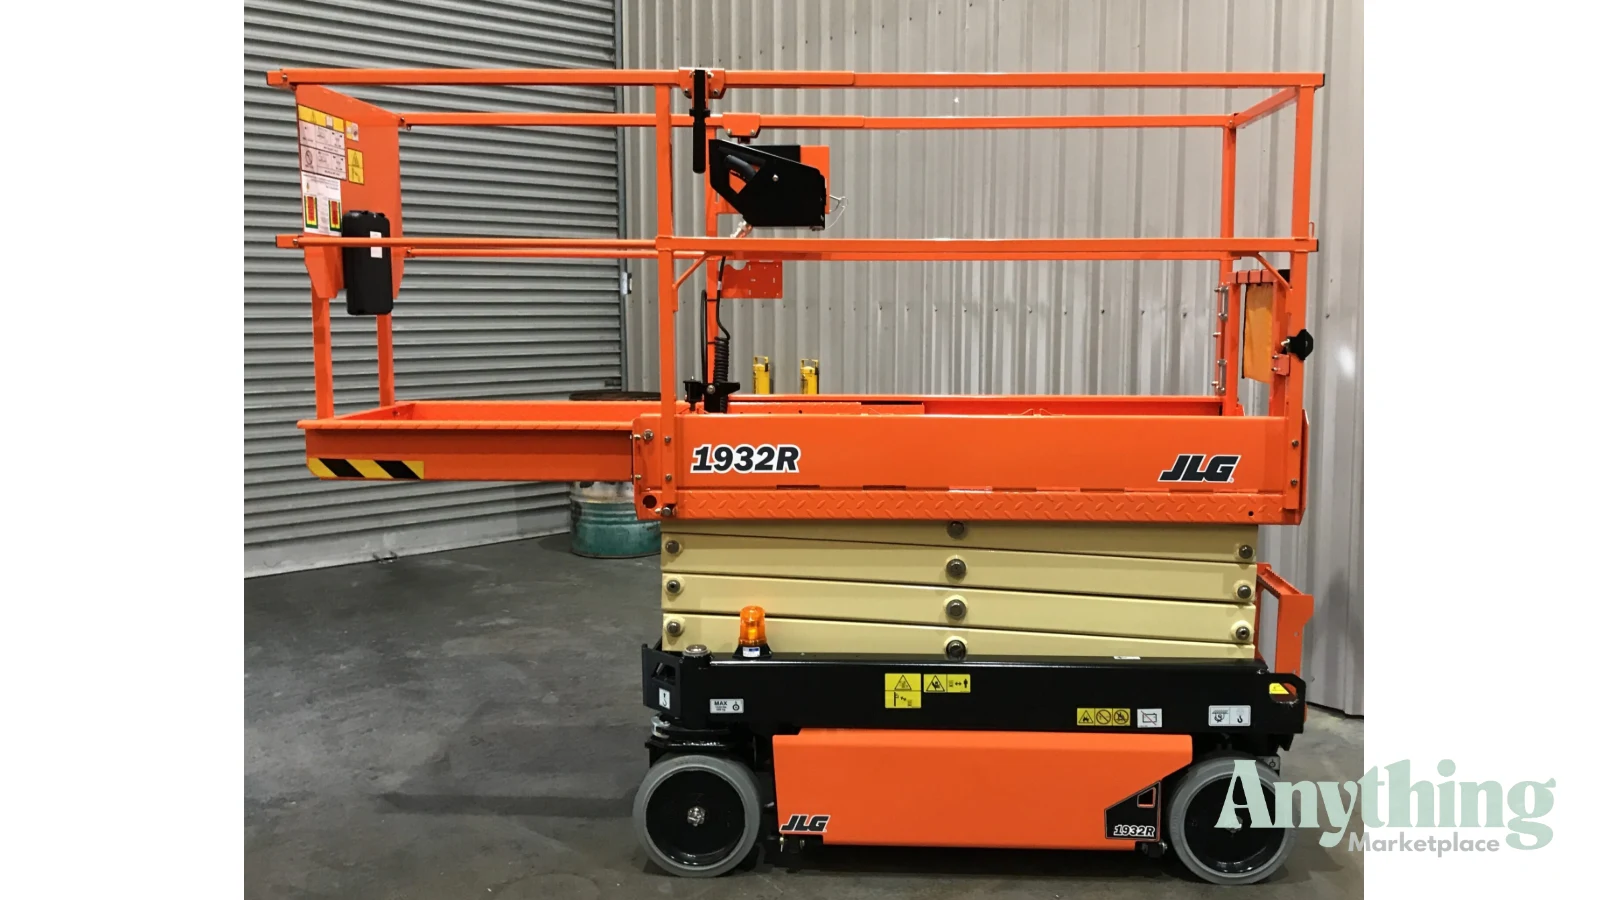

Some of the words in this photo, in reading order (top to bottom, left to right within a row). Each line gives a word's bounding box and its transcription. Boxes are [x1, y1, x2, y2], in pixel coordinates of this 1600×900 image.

[691, 445, 801, 473] 1932R
[1158, 454, 1241, 482] JLG
[779, 814, 831, 832] JLG
[1113, 824, 1156, 837] 1932R
